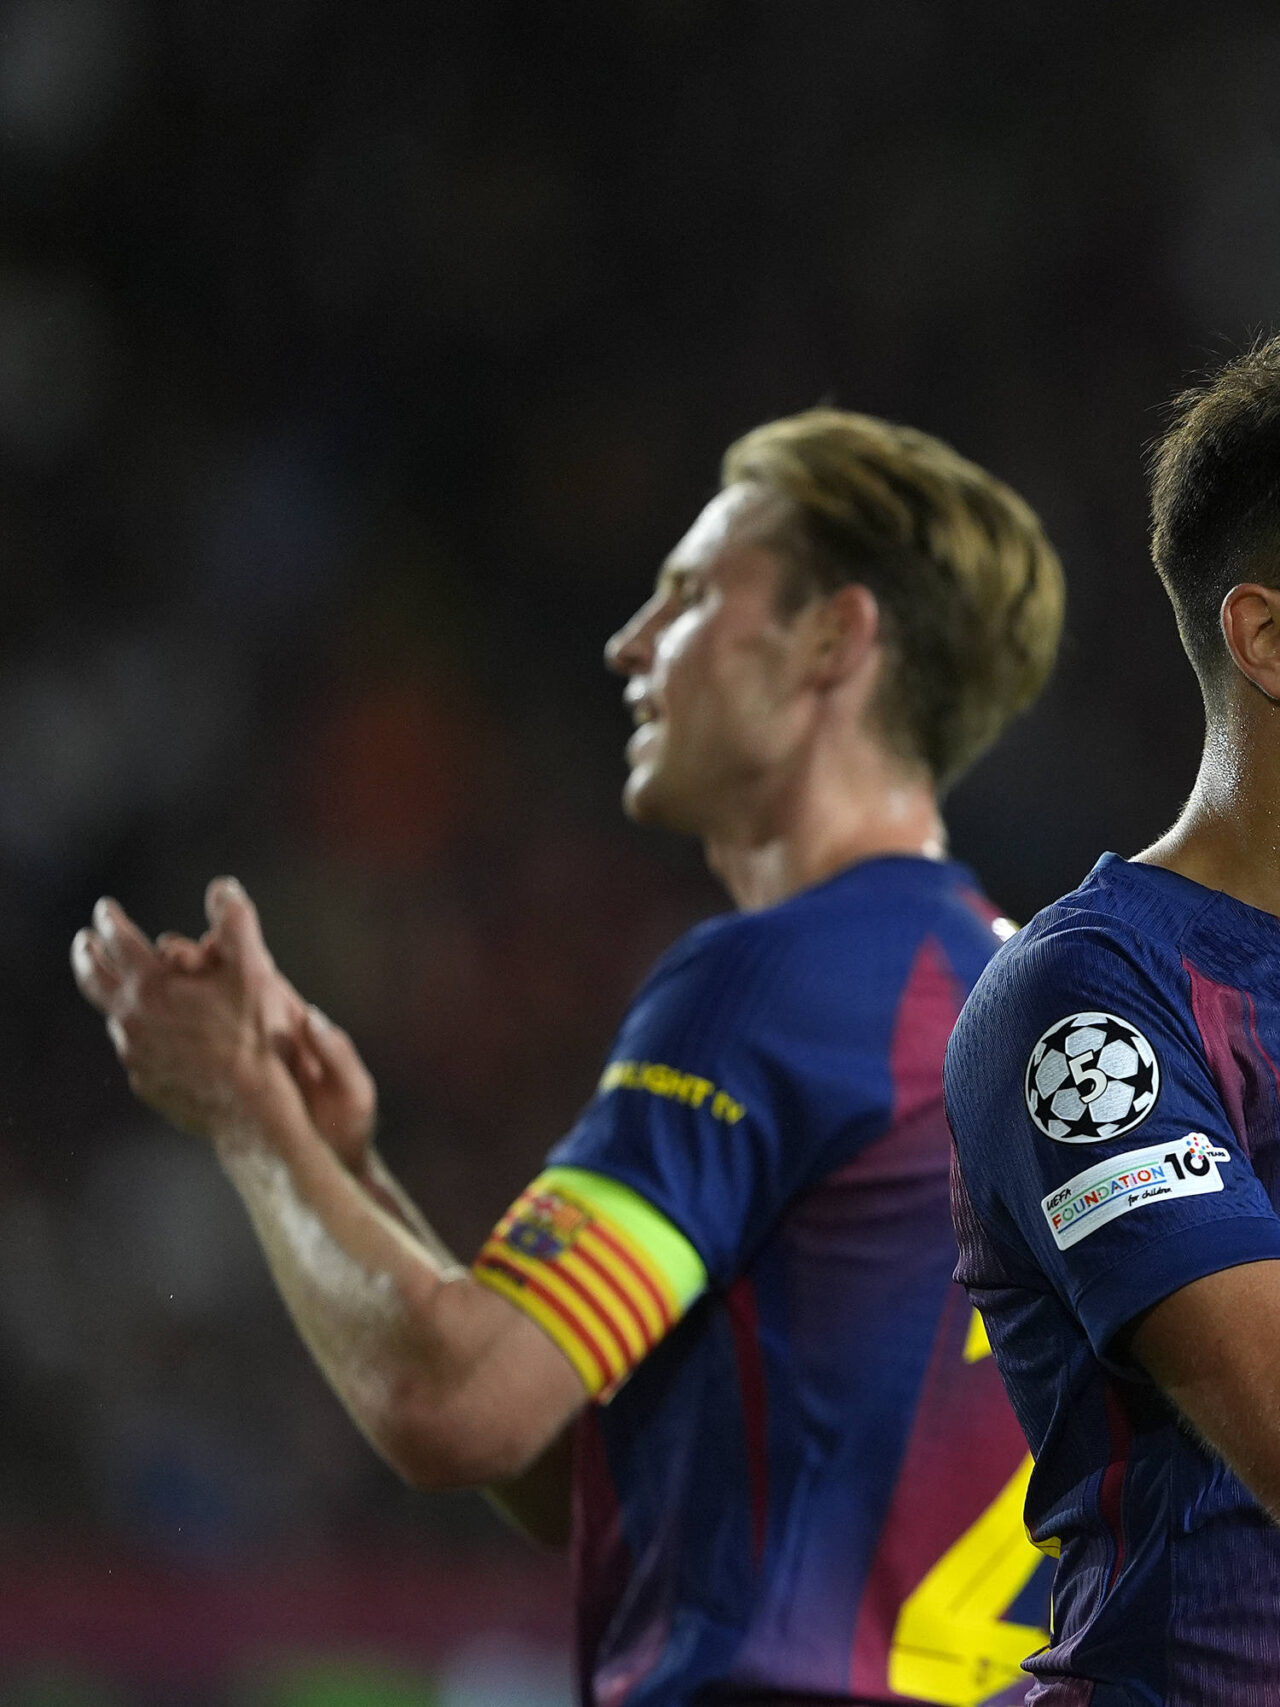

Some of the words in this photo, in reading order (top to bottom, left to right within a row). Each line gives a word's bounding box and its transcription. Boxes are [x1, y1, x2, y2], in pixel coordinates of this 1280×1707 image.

[1068, 1051, 1108, 1104] 5
[1163, 1149, 1210, 1180] 10
[1206, 1150, 1227, 1159] YEARS
[1046, 1188, 1072, 1211] UEFA
[1052, 1166, 1166, 1230] FOUNDATION
[1127, 1193, 1140, 1207] for
[1142, 1187, 1173, 1199] children
